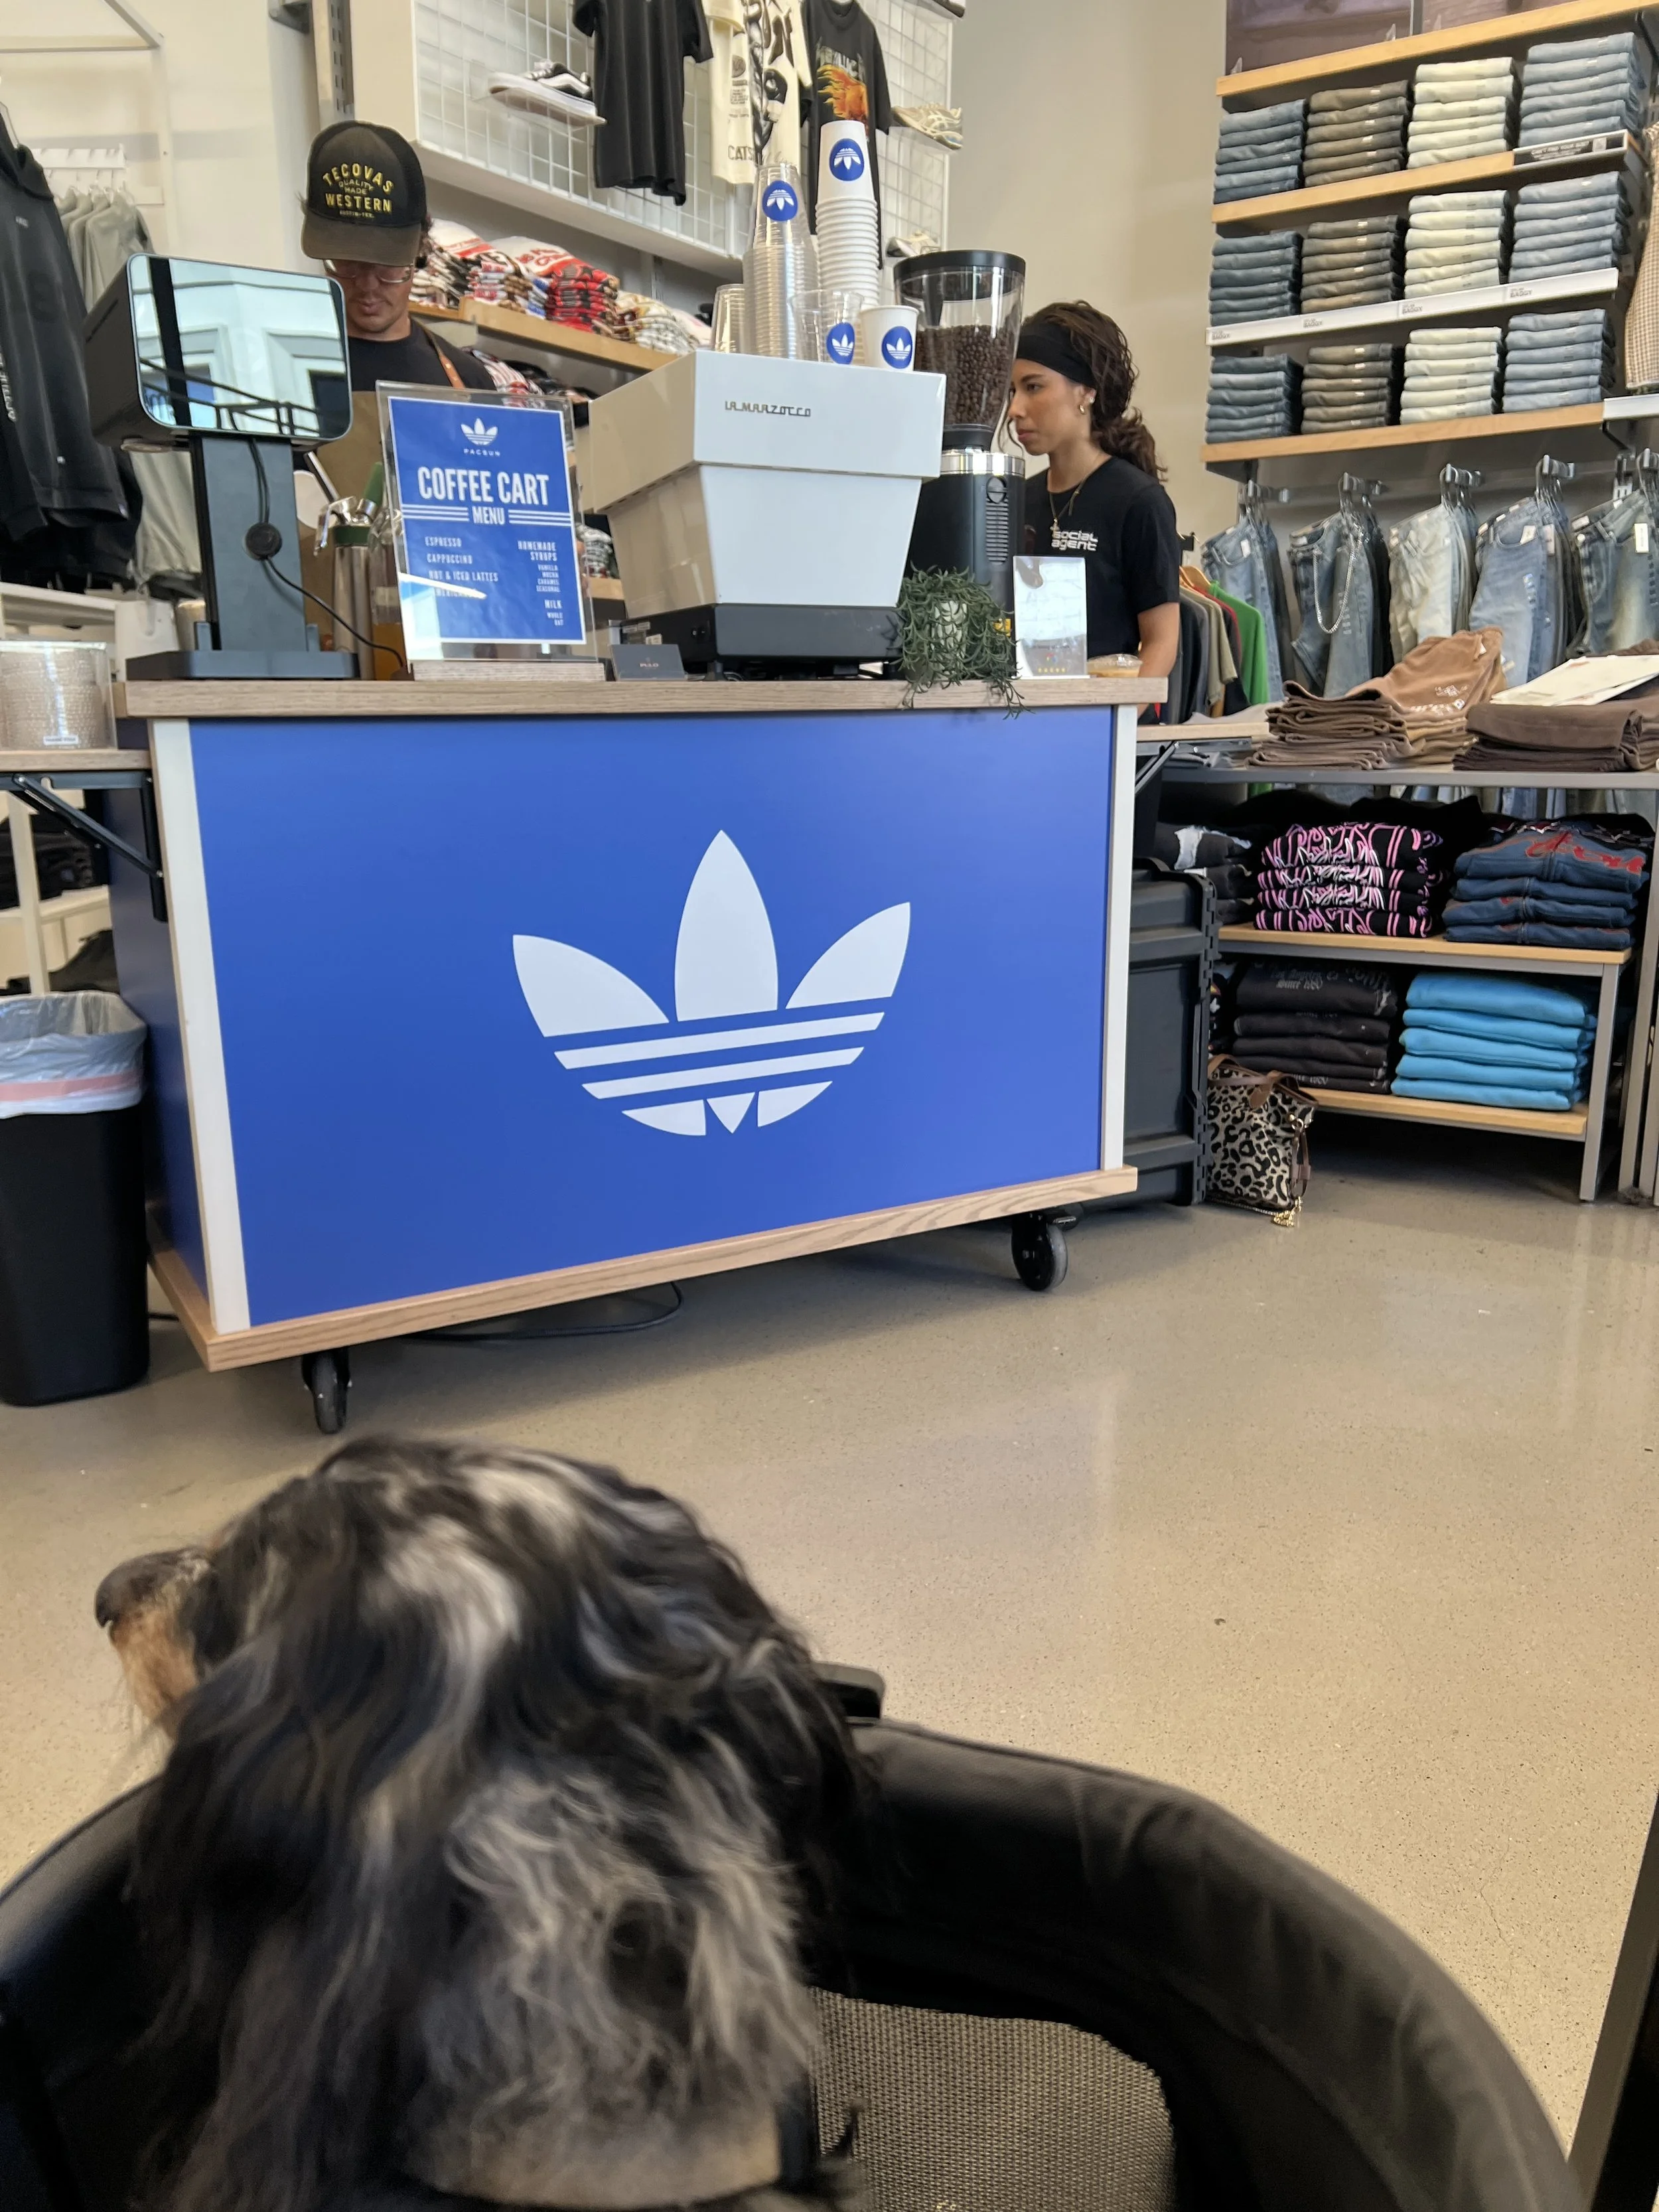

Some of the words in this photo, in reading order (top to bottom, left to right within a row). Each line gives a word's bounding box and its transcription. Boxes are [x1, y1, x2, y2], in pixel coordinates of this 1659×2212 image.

[323, 163, 395, 194] TECOVAS
[338, 180, 374, 191] QUALITY
[325, 193, 392, 213] WESTERN
[417, 467, 494, 502] COFFEE
[497, 472, 549, 506] CART
[472, 506, 506, 525] MENU
[425, 536, 462, 548] ESPRESSO
[1052, 530, 1098, 542] social
[518, 541, 556, 551] HOMEMADE
[1051, 539, 1097, 551] agent
[427, 553, 473, 564] CAPPUCCINO
[453, 571, 470, 581] ICED
[472, 572, 498, 582] LATTES
[544, 600, 562, 609] MILK
